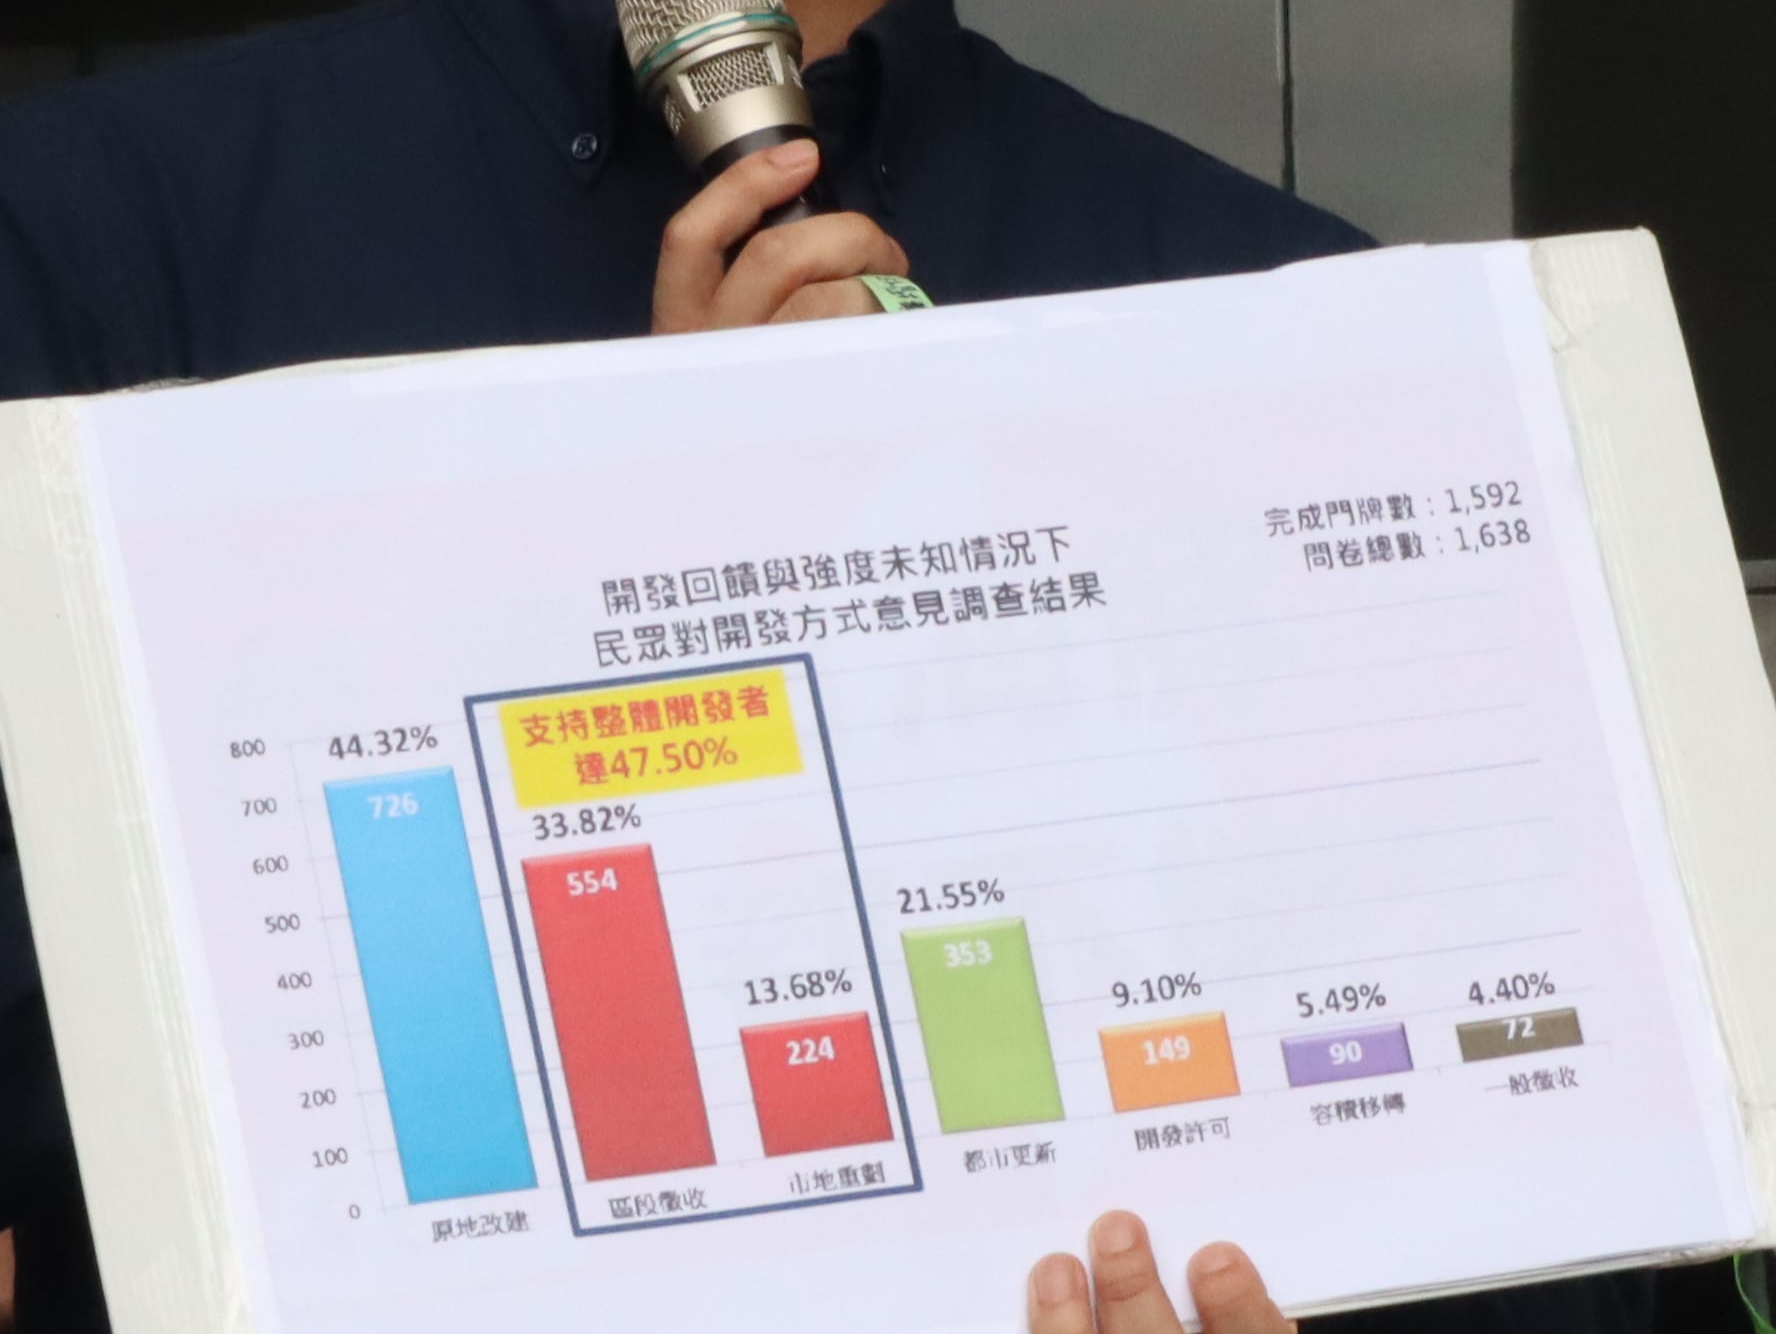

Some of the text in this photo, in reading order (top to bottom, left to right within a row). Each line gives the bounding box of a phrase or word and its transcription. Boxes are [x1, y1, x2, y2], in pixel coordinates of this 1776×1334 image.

[601, 525, 1071, 617] 開發回饋與強度未知情況下
[593, 571, 1107, 668] 民眾對開發方式意見調查結果
[519, 684, 770, 748] 支持整體開發者
[230, 738, 266, 759] 800
[328, 724, 438, 760] 44.32%
[574, 736, 738, 786] 達47.50%
[242, 797, 277, 817] 700
[366, 792, 419, 820] 726
[532, 803, 641, 840] 33.82%
[252, 855, 289, 875] 600
[565, 867, 619, 896] 554
[897, 877, 1005, 914] 21.55%
[264, 913, 300, 934] 500
[943, 939, 993, 969] 353
[277, 971, 312, 990] 400
[744, 968, 853, 1006] 13.68%
[1111, 971, 1202, 1008] 9.10%
[1468, 971, 1555, 1006] 4.40%
[1296, 982, 1386, 1018] 5.49%
[288, 1029, 325, 1050] 300
[1501, 1017, 1536, 1040] 72
[785, 1035, 835, 1066] 224
[1141, 1035, 1191, 1065] 149
[1328, 1040, 1363, 1065] 90
[300, 1087, 336, 1109] 200
[1134, 1116, 1231, 1152] 開發許可
[312, 1146, 348, 1168] 100
[963, 1140, 1057, 1173] 都市更新
[348, 1203, 361, 1220] 0
